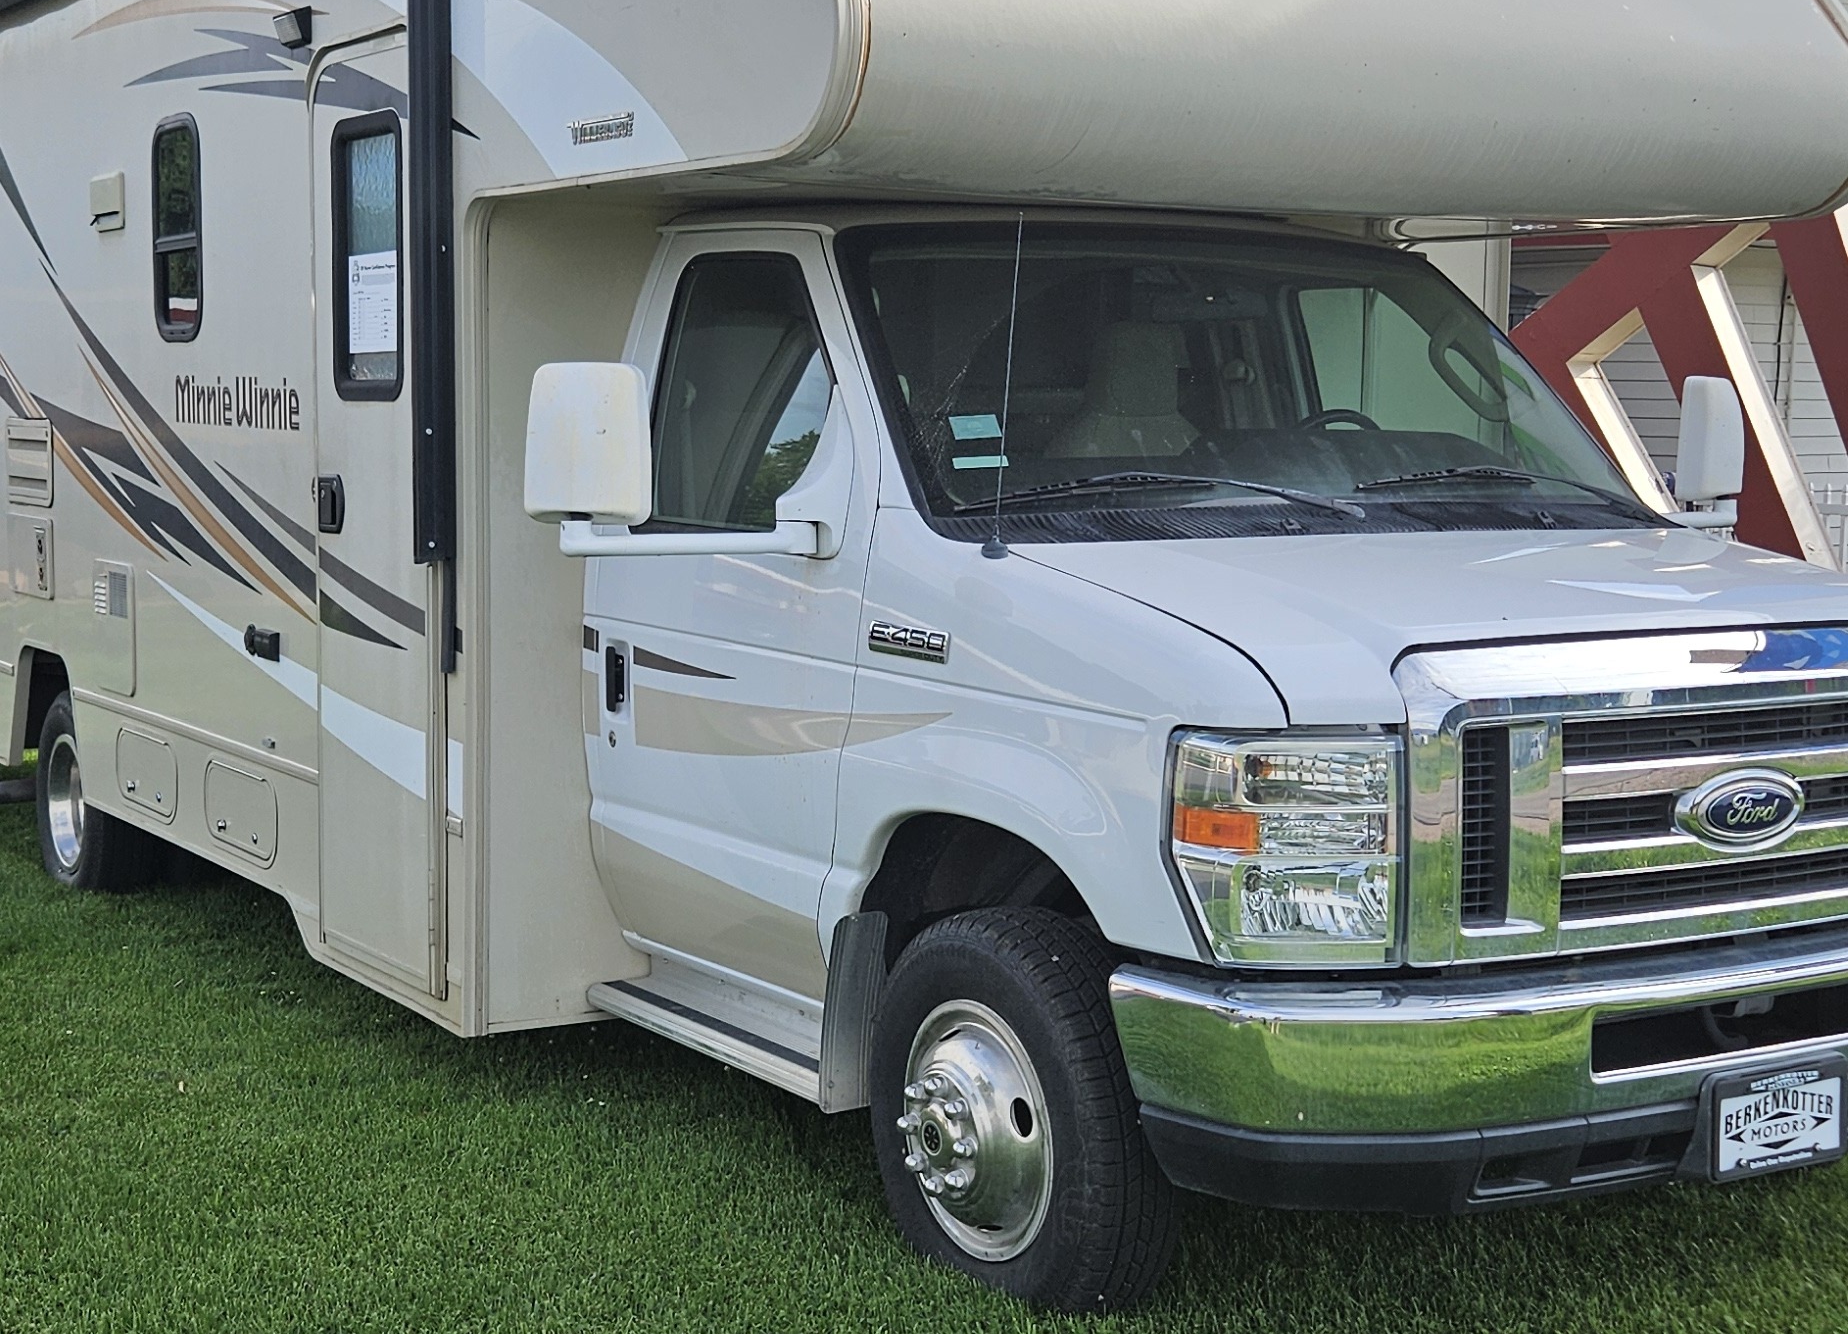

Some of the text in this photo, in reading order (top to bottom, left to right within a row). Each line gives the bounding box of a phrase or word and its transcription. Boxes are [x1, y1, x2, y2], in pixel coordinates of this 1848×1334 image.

[175, 374, 300, 431] Minnie Winnie
[1726, 792, 1779, 826] Ford
[1724, 1088, 1833, 1136] BERKENKOTTER
[1750, 1118, 1806, 1141] MOTORS
